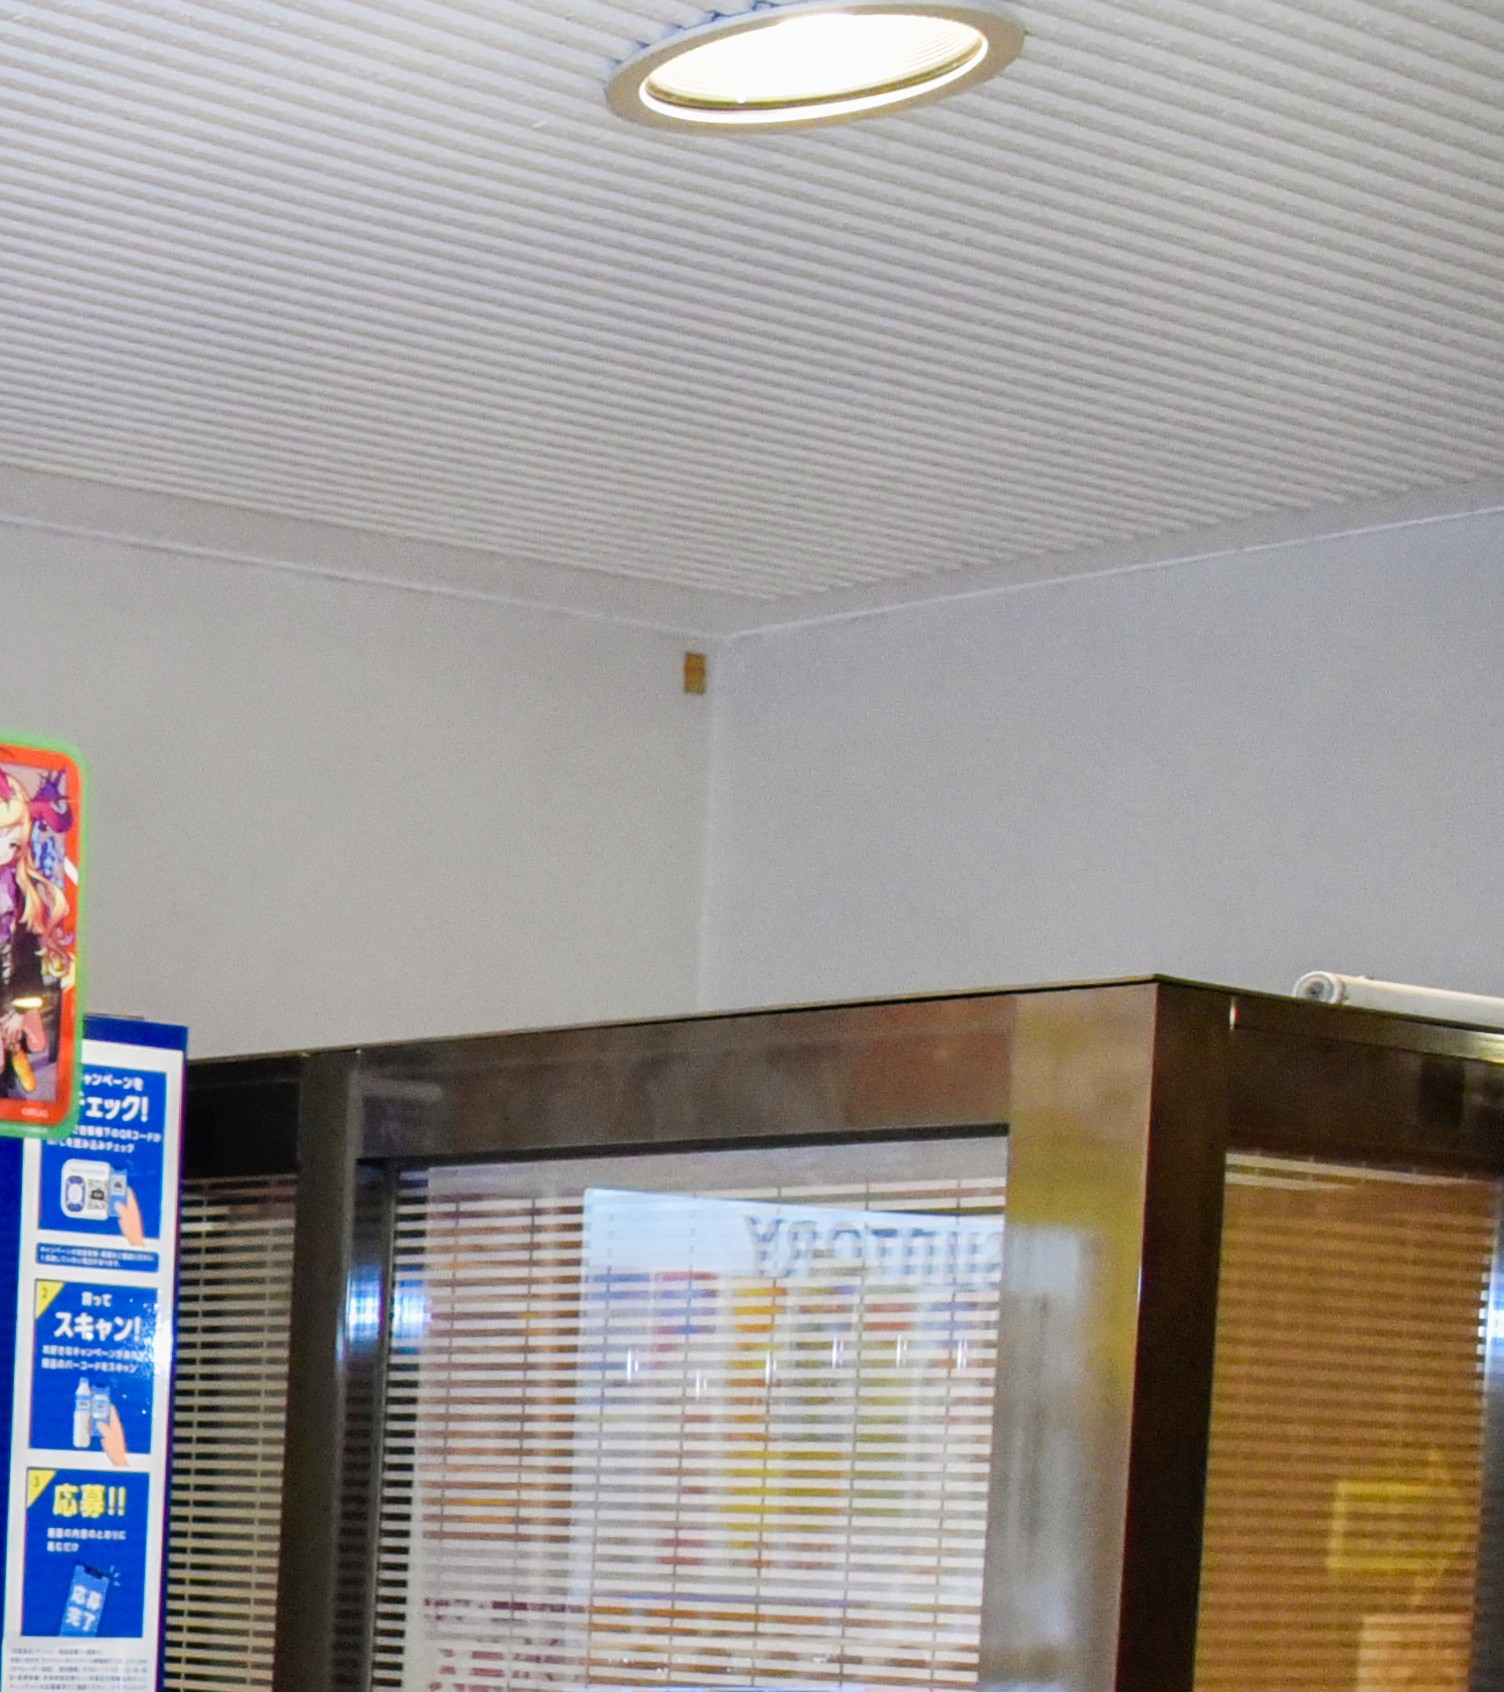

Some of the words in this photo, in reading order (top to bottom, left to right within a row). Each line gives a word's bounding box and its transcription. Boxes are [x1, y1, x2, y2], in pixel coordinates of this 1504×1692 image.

[41, 1287, 48, 1299] 2
[54, 1312, 142, 1342] スキャン!
[33, 1475, 40, 1488] 3
[54, 1484, 127, 1518] 応募!!
